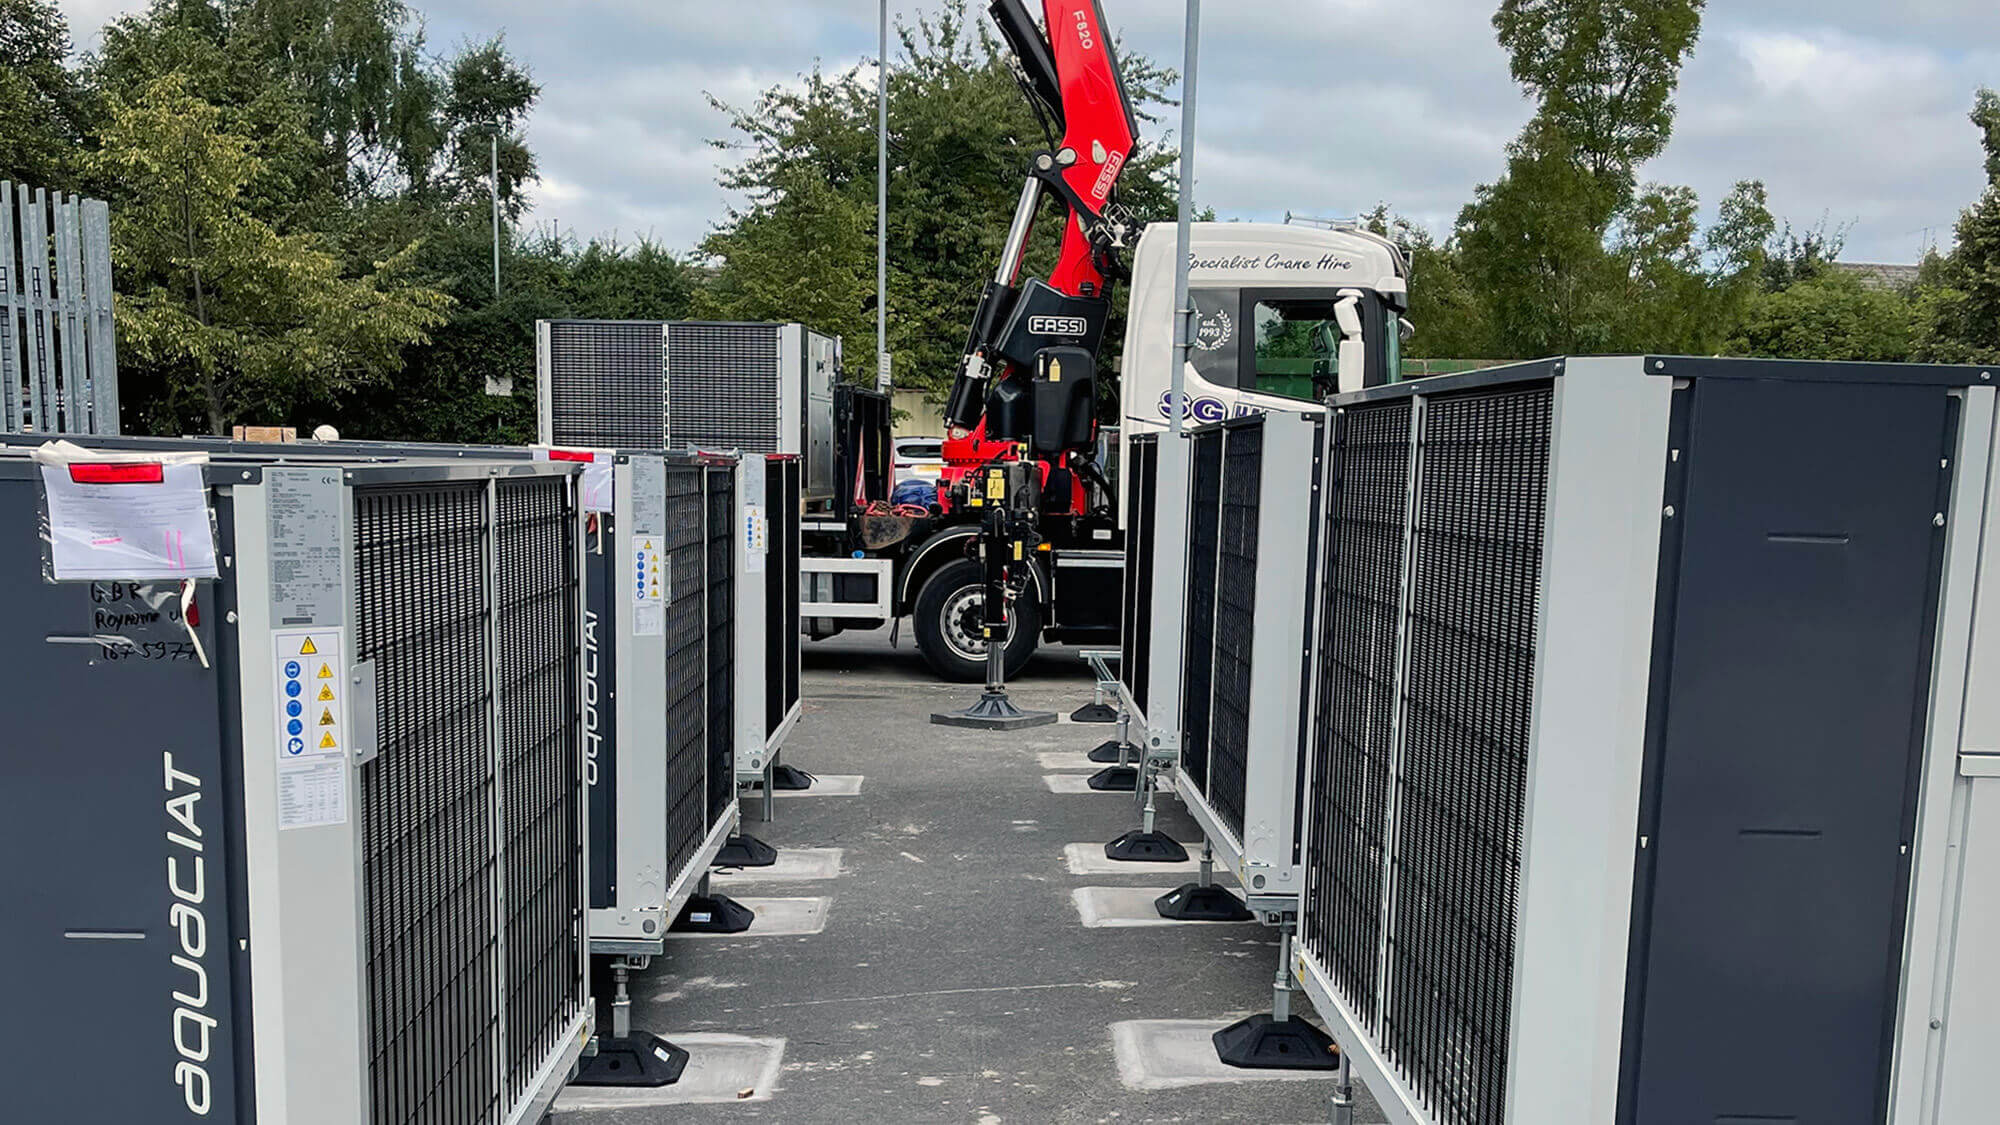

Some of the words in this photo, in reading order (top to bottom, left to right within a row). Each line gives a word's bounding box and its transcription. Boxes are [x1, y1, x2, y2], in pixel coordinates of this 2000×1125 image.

[1073, 10, 1093, 49] F820
[1094, 155, 1120, 195] FASSI
[1265, 253, 1311, 270] Crane
[1316, 253, 1352, 270] Hire
[1033, 318, 1083, 333] FASSI
[1199, 328, 1220, 337] 1993
[163, 751, 218, 1116] aquaCIAT
